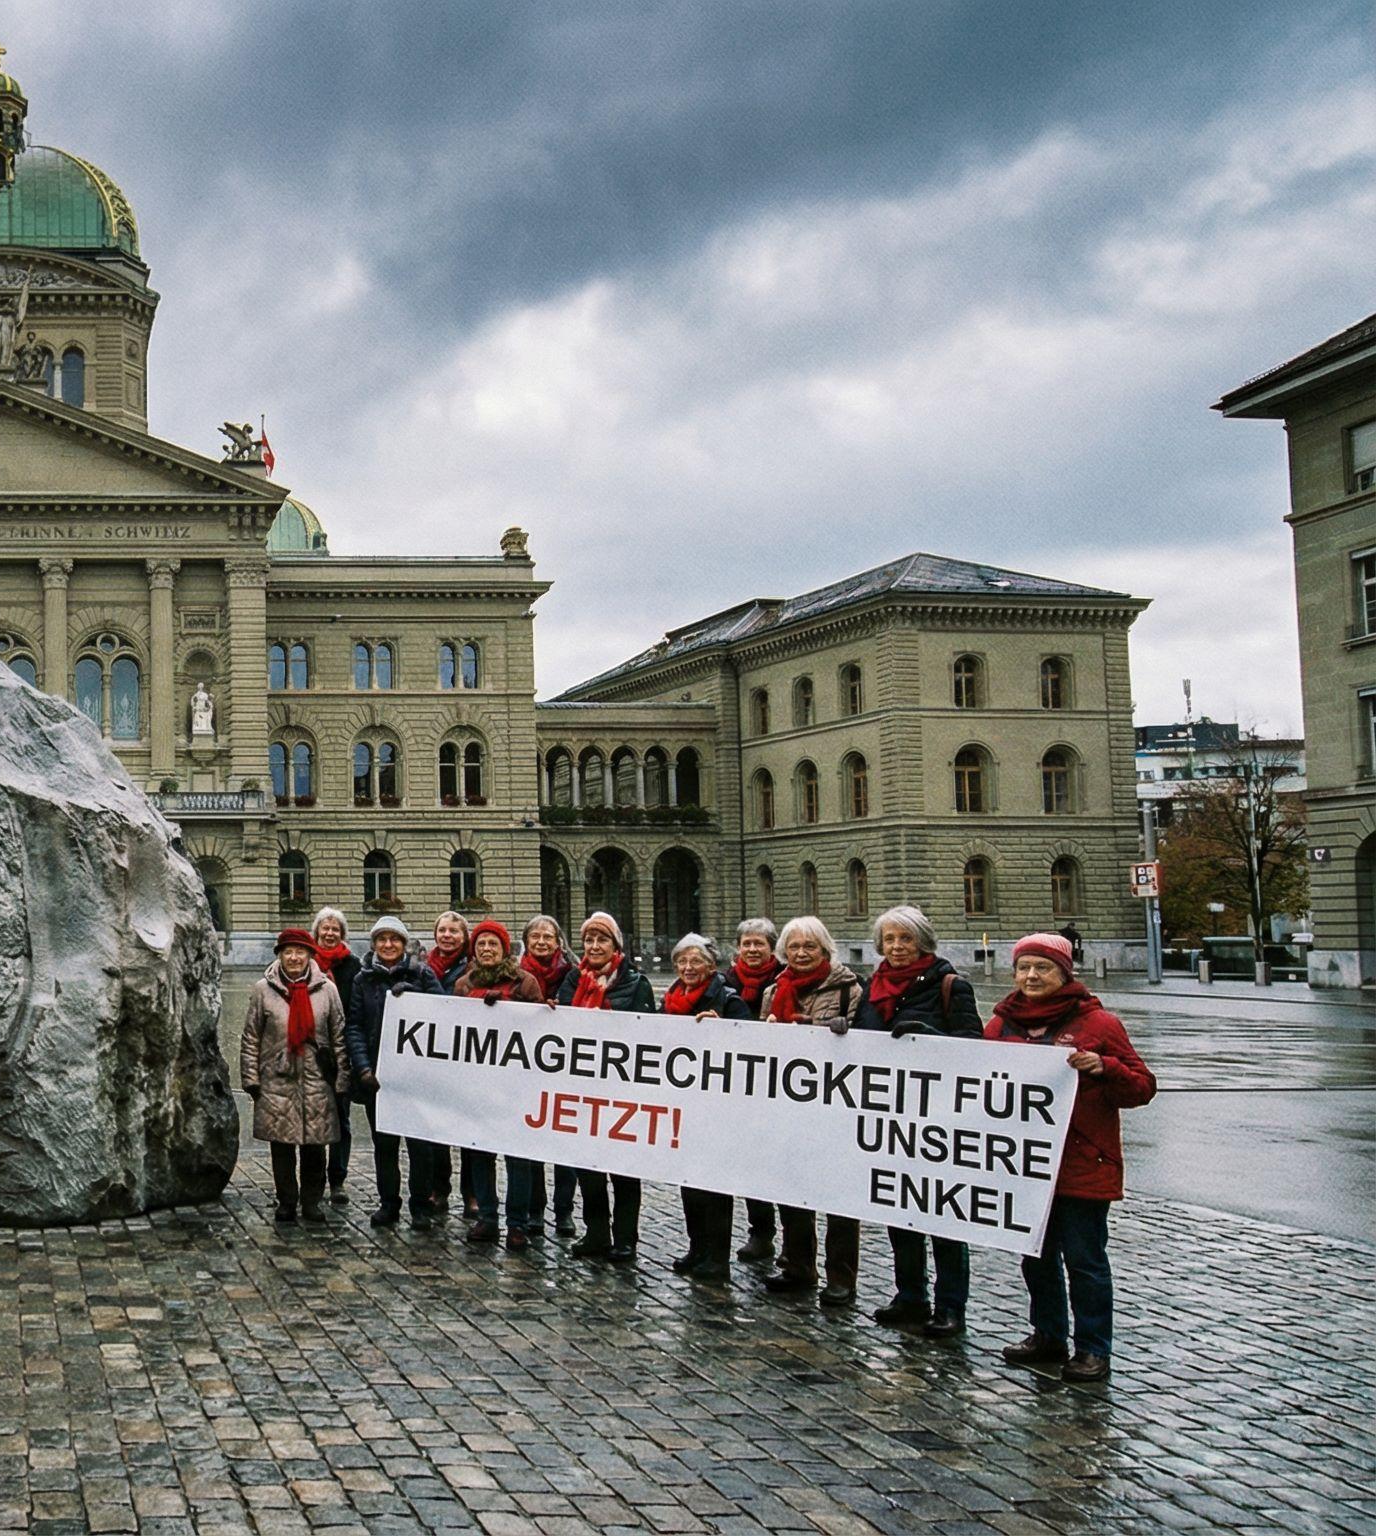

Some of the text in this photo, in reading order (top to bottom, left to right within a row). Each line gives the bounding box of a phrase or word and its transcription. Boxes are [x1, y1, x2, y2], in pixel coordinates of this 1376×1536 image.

[396, 1018, 1056, 1126] KLIMAGERECHTIGKEIT FÜR
[525, 1091, 682, 1150] JETZT!
[856, 1114, 1052, 1181] UNSERE
[870, 1167, 1032, 1234] ENKEL
